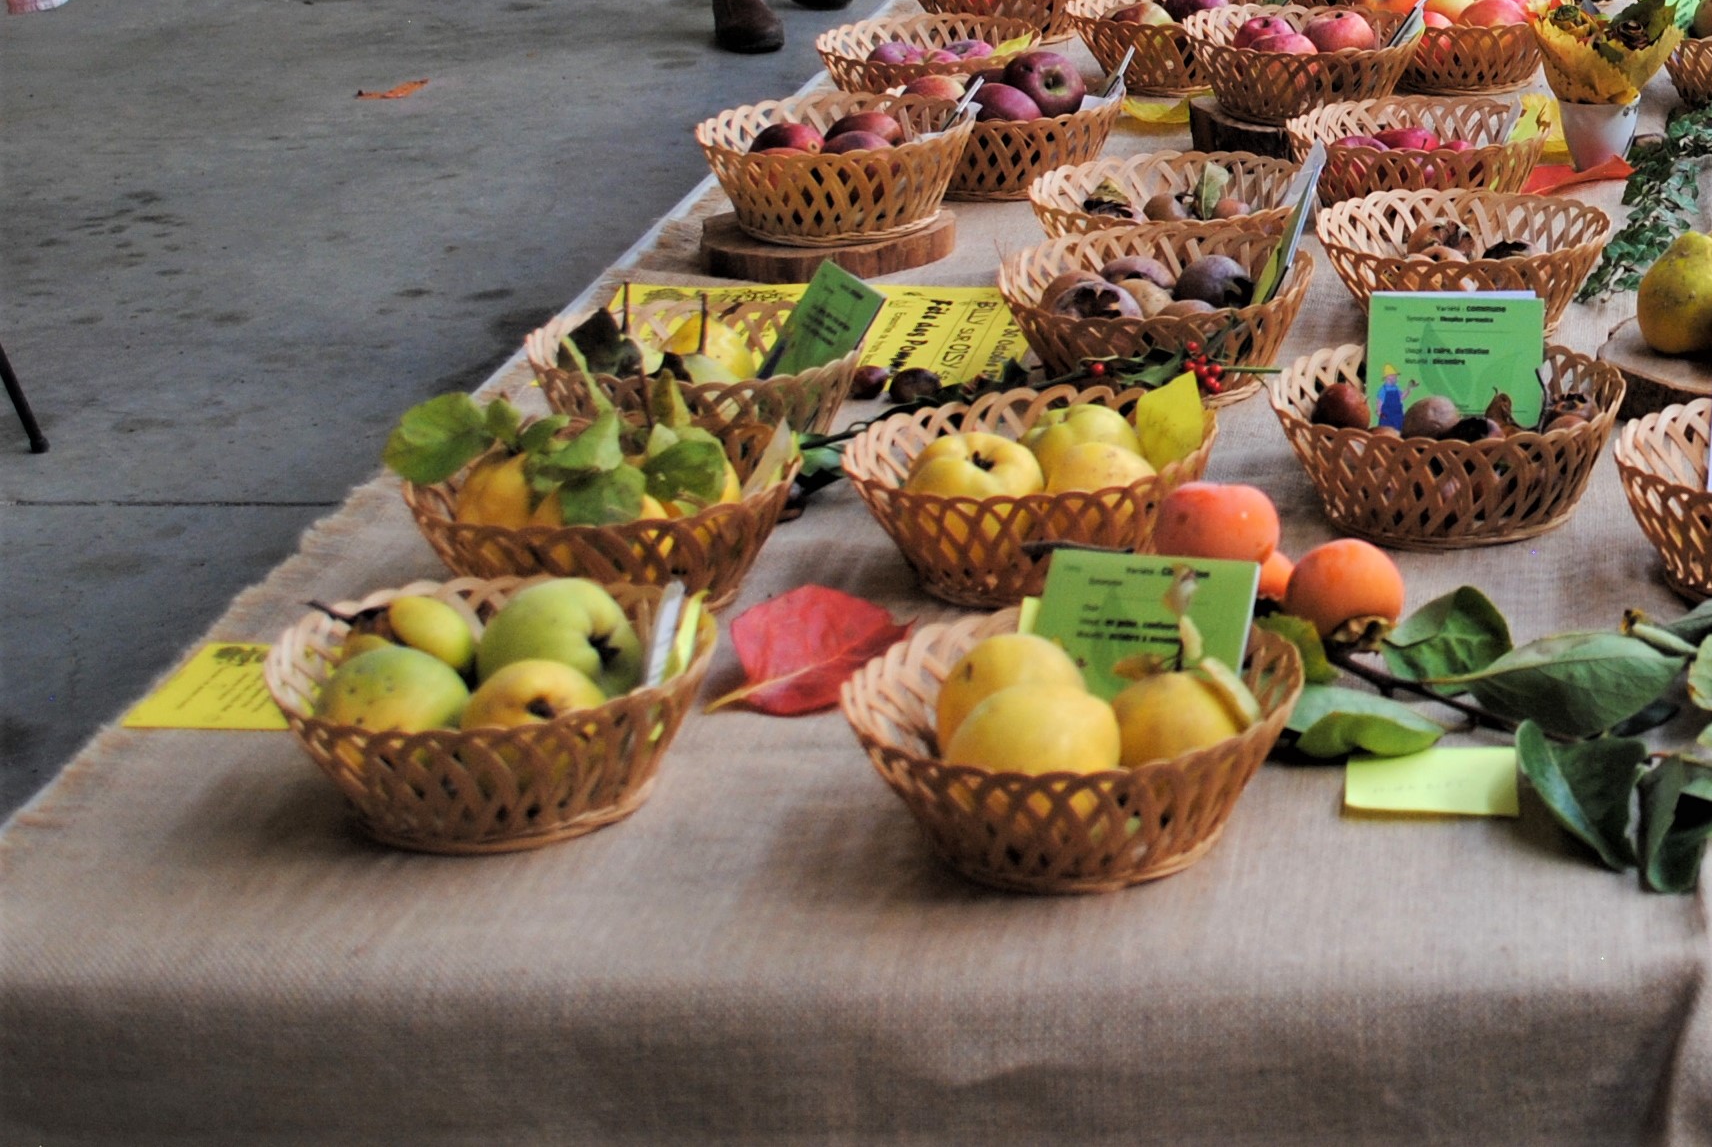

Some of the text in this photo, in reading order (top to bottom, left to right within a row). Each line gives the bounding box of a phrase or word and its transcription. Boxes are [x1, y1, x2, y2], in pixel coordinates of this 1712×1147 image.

[966, 300, 997, 325] BILLY
[889, 299, 953, 369] Fête des Pomm
[953, 327, 975, 342] SUR
[940, 343, 970, 369] OISY
